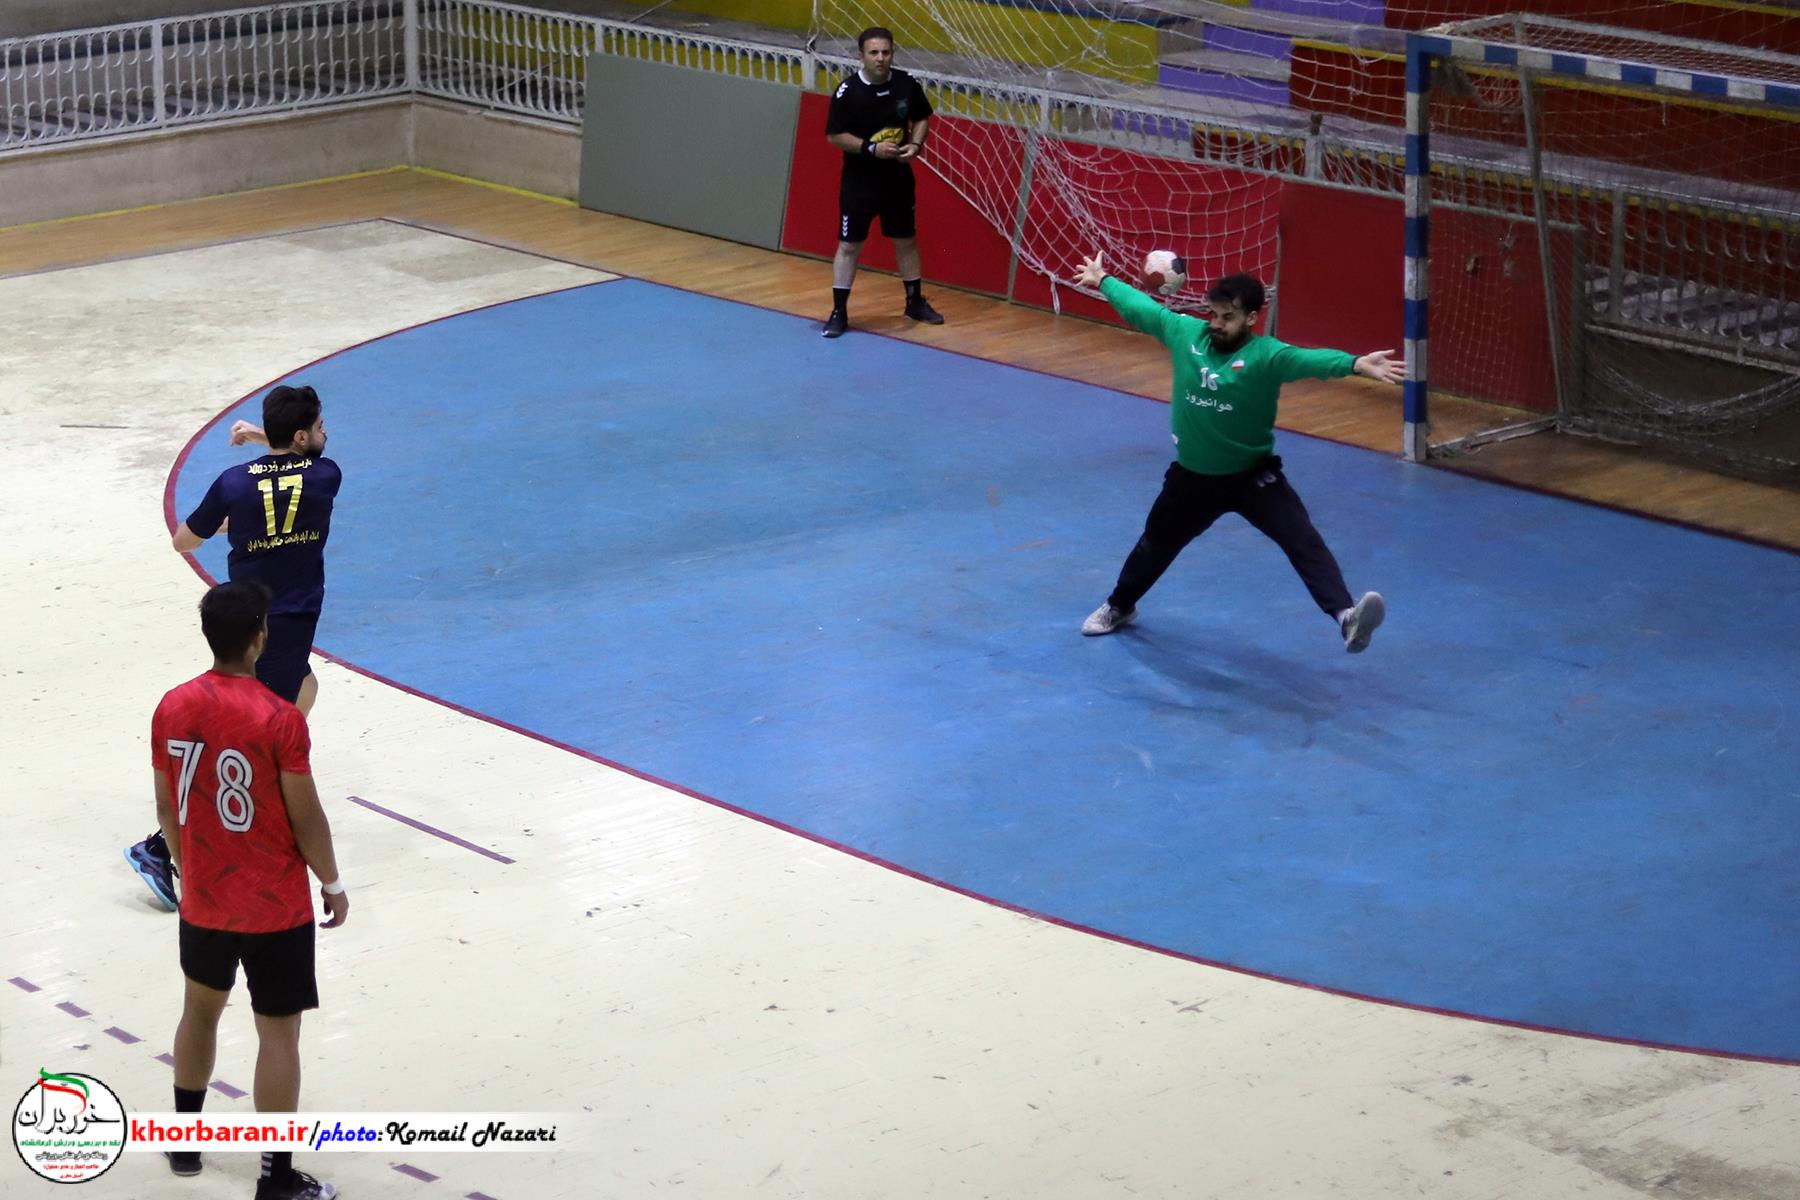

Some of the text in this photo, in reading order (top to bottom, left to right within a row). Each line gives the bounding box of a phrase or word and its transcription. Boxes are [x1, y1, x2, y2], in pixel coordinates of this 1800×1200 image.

[1200, 367, 1220, 391] 16
[257, 473, 304, 537] 17
[167, 739, 255, 832] 78
